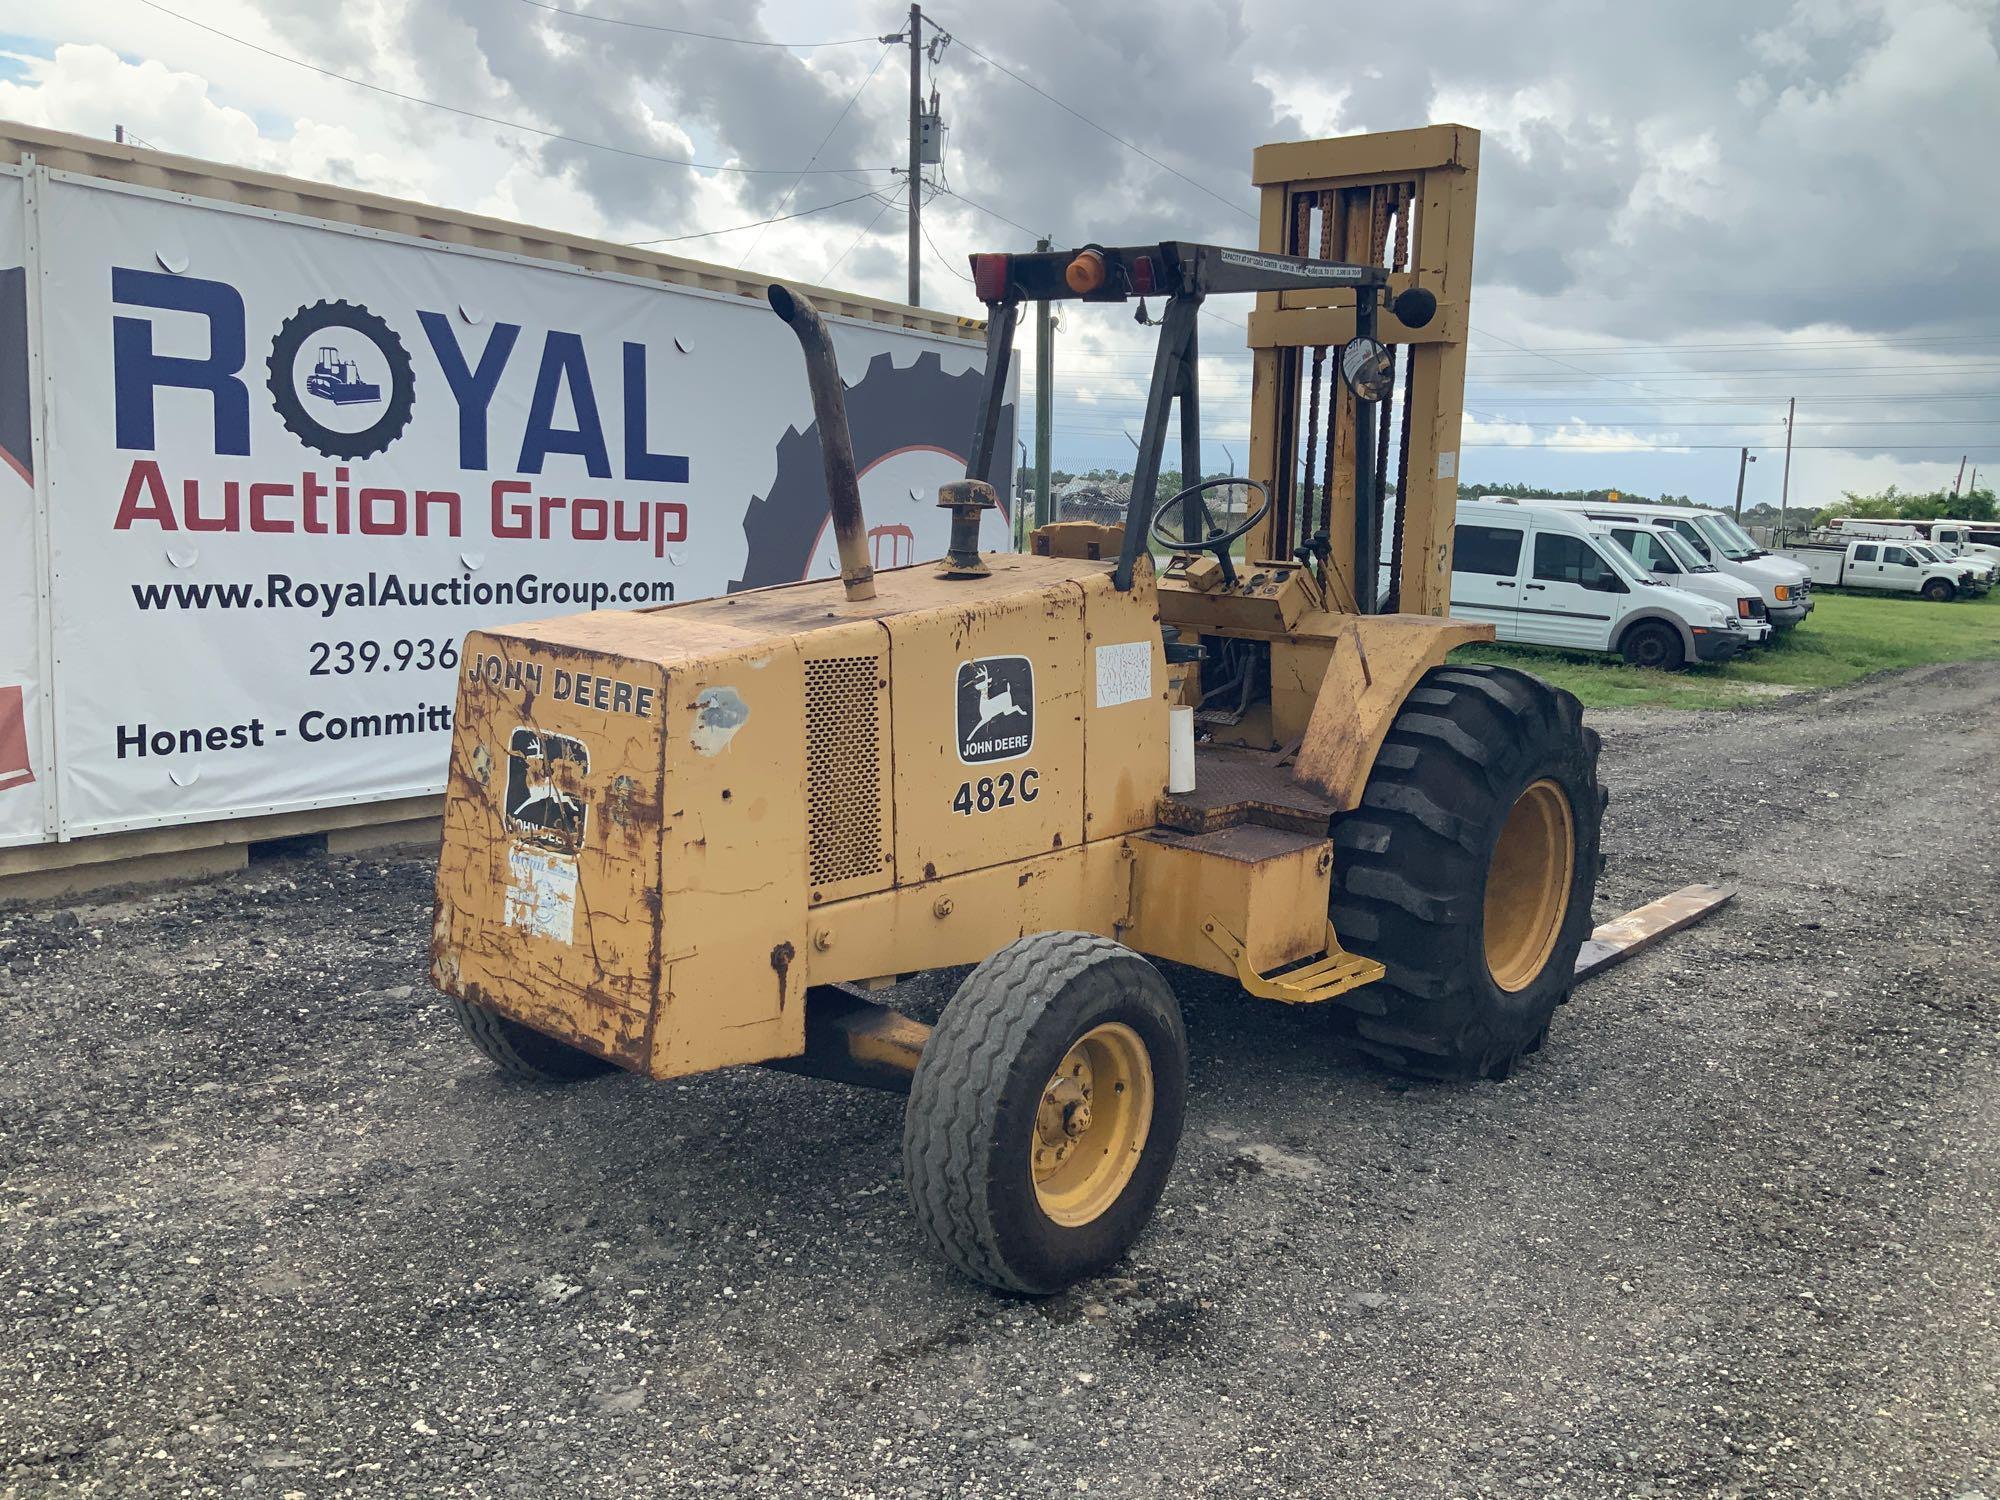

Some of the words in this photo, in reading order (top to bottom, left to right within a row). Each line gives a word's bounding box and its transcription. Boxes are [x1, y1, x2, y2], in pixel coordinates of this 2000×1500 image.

[1222, 251, 1241, 262] CAPACITY
[1253, 256, 1263, 266] LOAD
[112, 266, 689, 483] ROYAL
[113, 459, 462, 537] Auction
[491, 480, 688, 558] Group
[131, 572, 674, 617] www.RoyalAuctionGroup.com
[309, 638, 459, 676] 239.936
[468, 653, 544, 695] JOHN
[553, 668, 655, 718] DEERE
[116, 719, 265, 759] Honest
[299, 702, 456, 743] Committ
[963, 739, 993, 757] JOHN
[994, 734, 1028, 752] DEERE
[952, 767, 1040, 817] 482C
